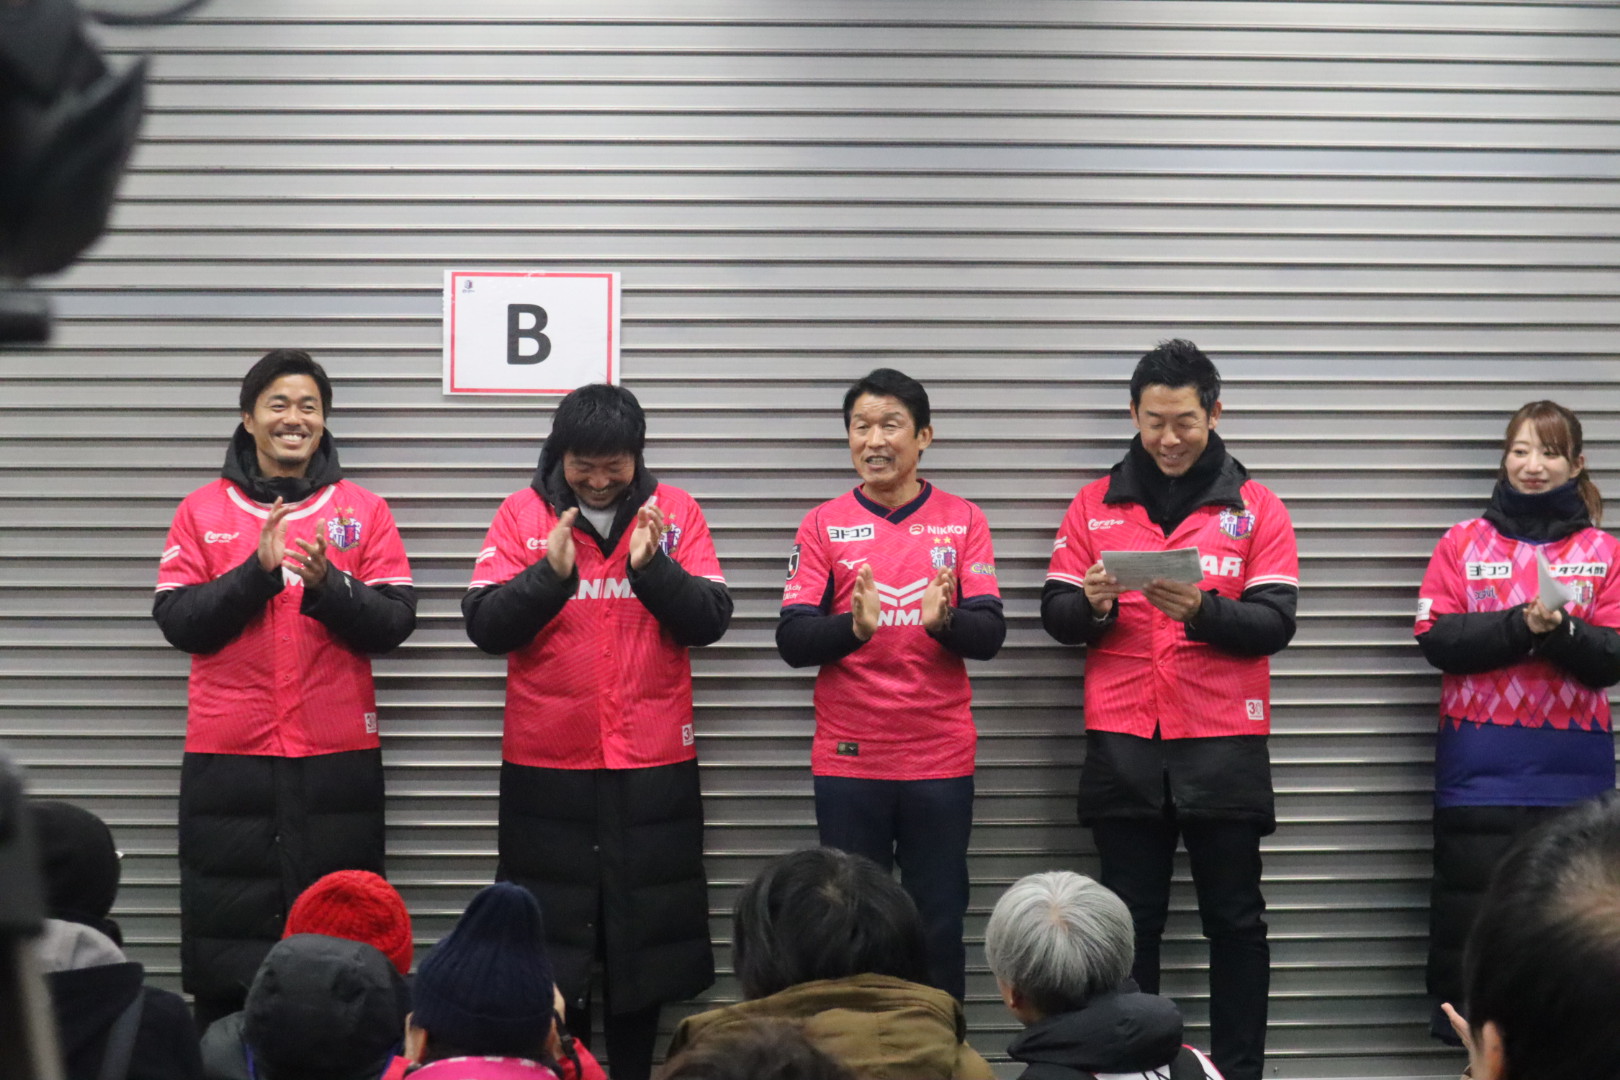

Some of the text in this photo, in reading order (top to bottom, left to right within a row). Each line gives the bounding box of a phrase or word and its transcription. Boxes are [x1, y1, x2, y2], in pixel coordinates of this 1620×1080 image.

[507, 303, 552, 365] B
[829, 527, 872, 539] ヨドコウ
[568, 577, 637, 600] NM
